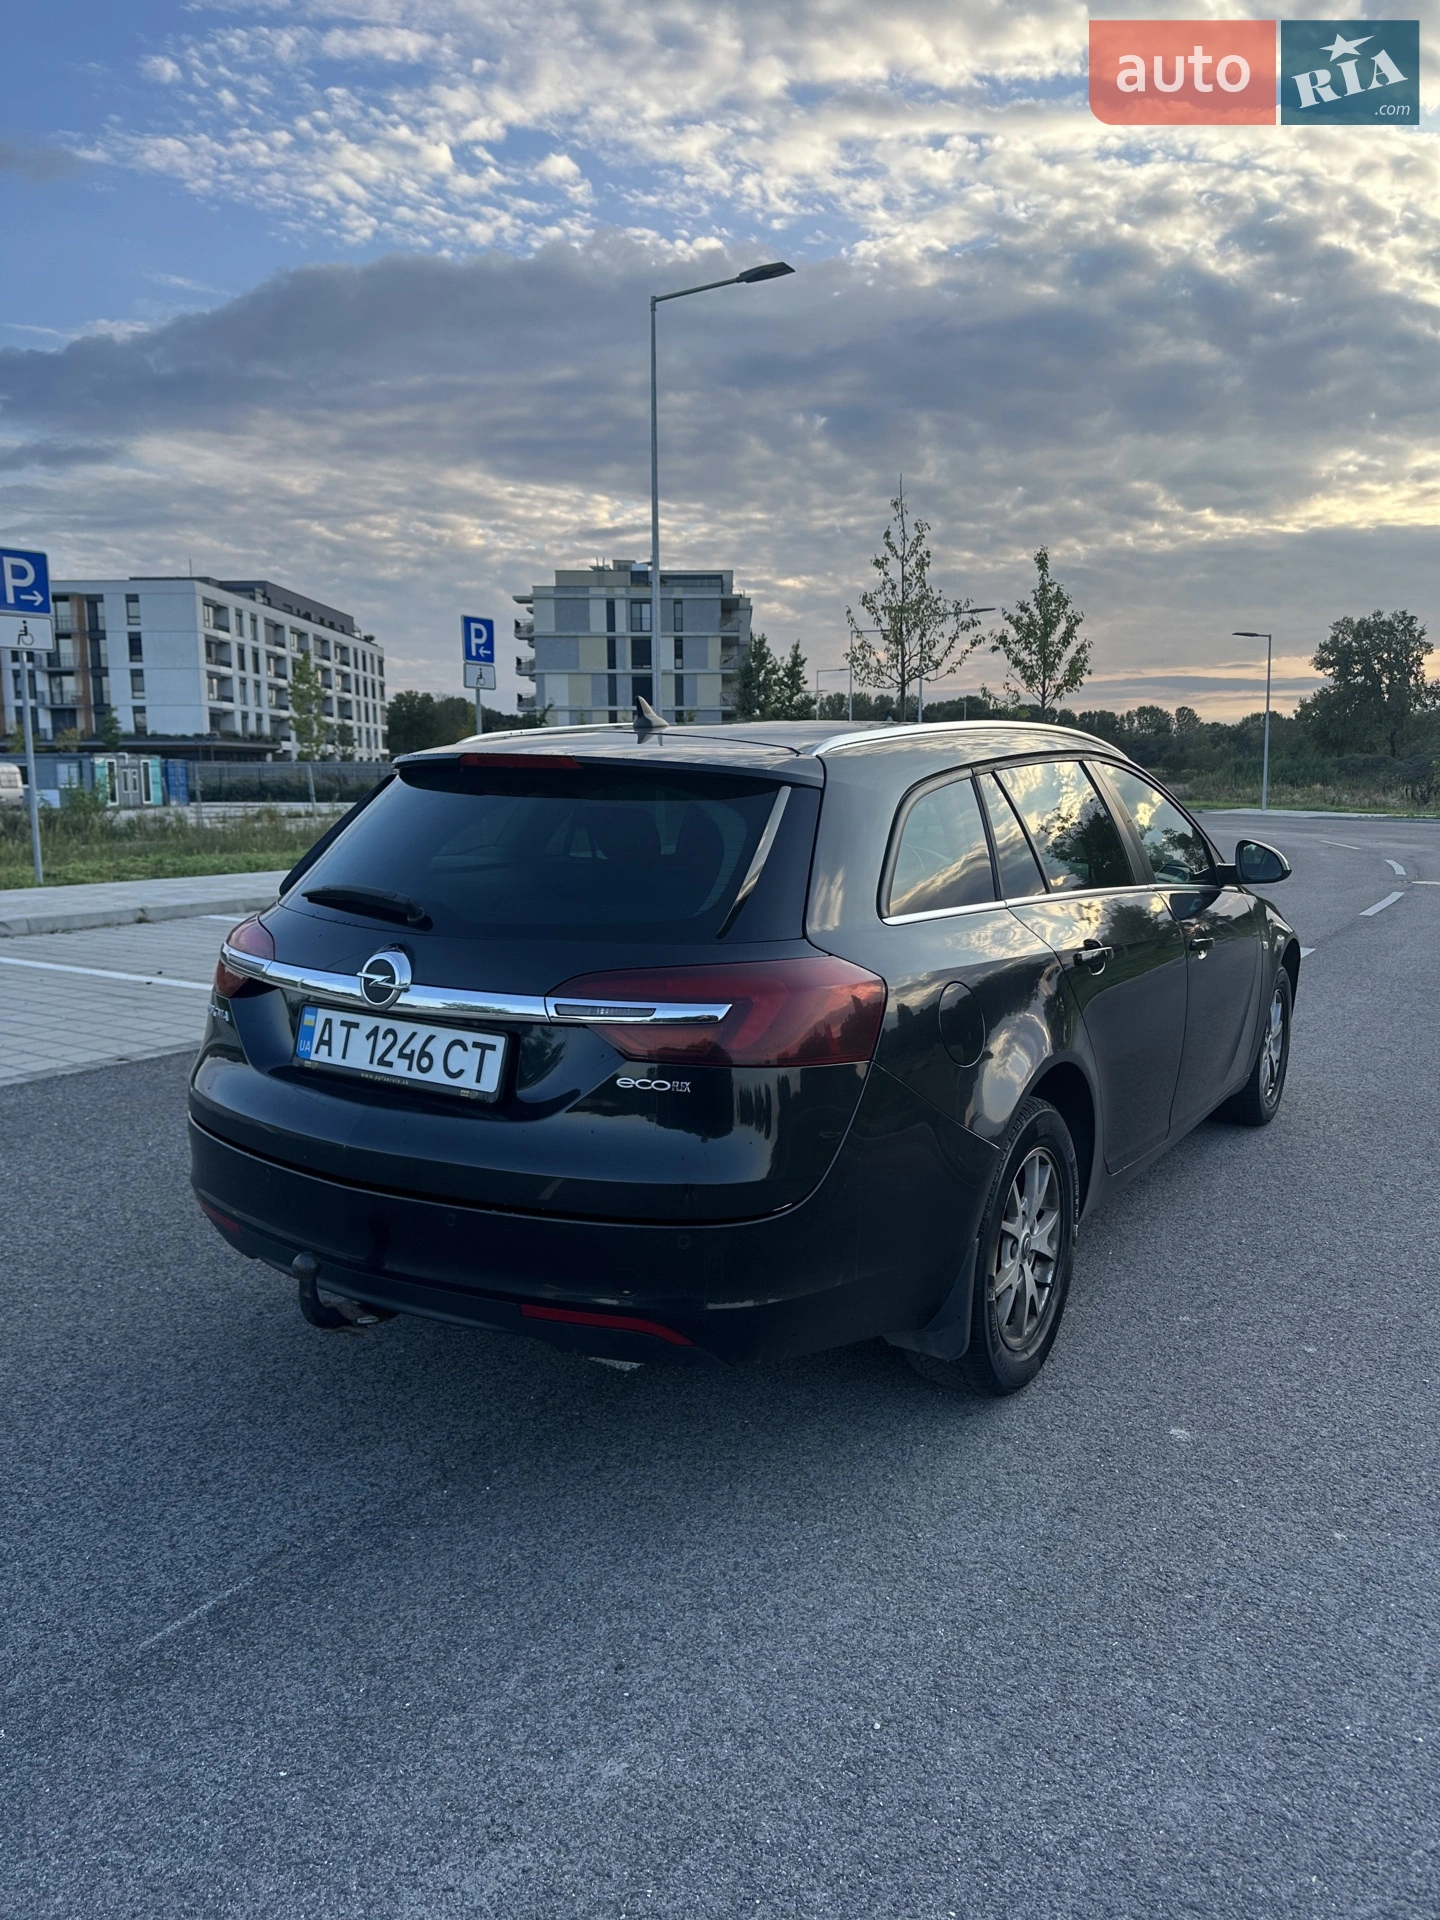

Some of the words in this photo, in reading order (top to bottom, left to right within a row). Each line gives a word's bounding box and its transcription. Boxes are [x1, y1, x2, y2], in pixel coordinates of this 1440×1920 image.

[2, 556, 36, 604] P
[470, 622, 488, 657] P
[299, 1039, 311, 1053] UA
[314, 1017, 360, 1060] AT
[365, 1025, 437, 1074] 1246
[443, 1039, 497, 1084] CT
